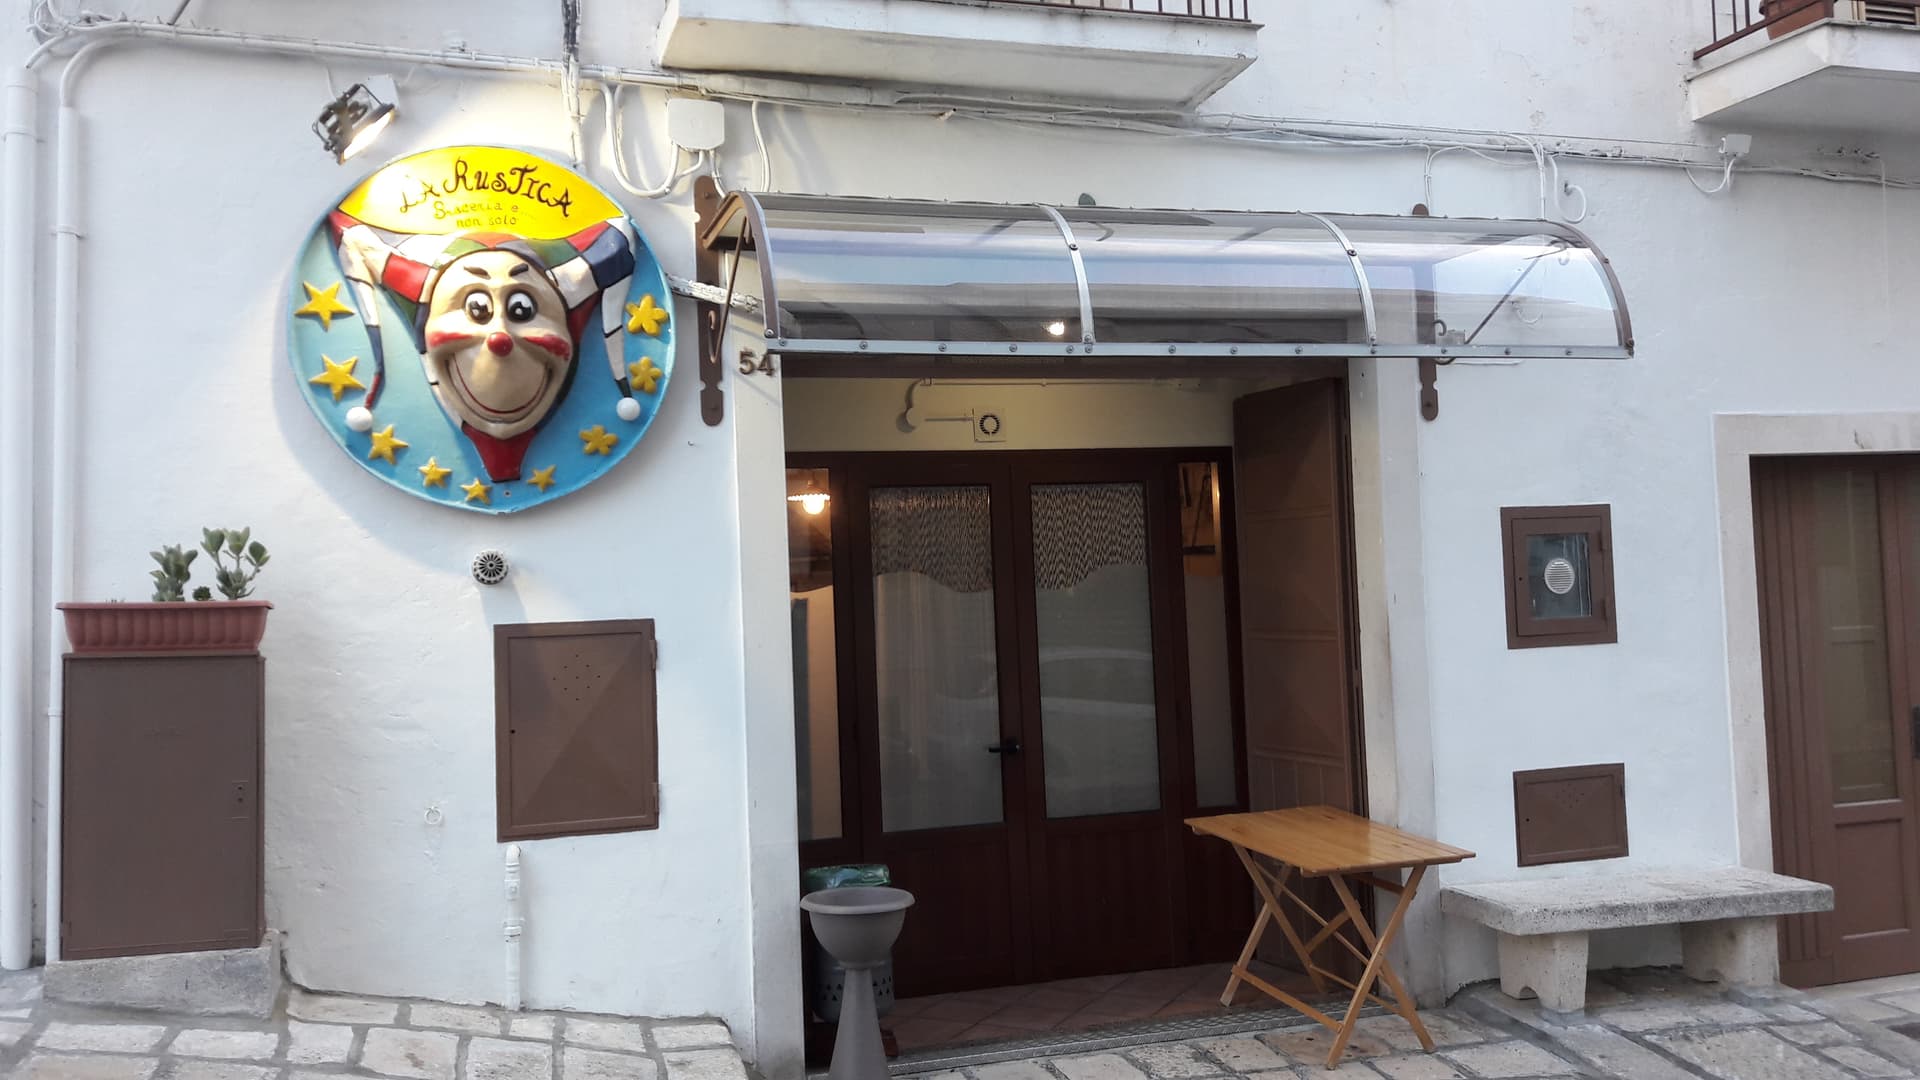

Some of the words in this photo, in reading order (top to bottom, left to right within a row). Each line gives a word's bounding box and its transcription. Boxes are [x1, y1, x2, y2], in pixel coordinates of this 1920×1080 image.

[400, 176, 440, 213] LA
[456, 218, 481, 228] non
[488, 215, 517, 226] solo
[739, 351, 774, 377] 54
